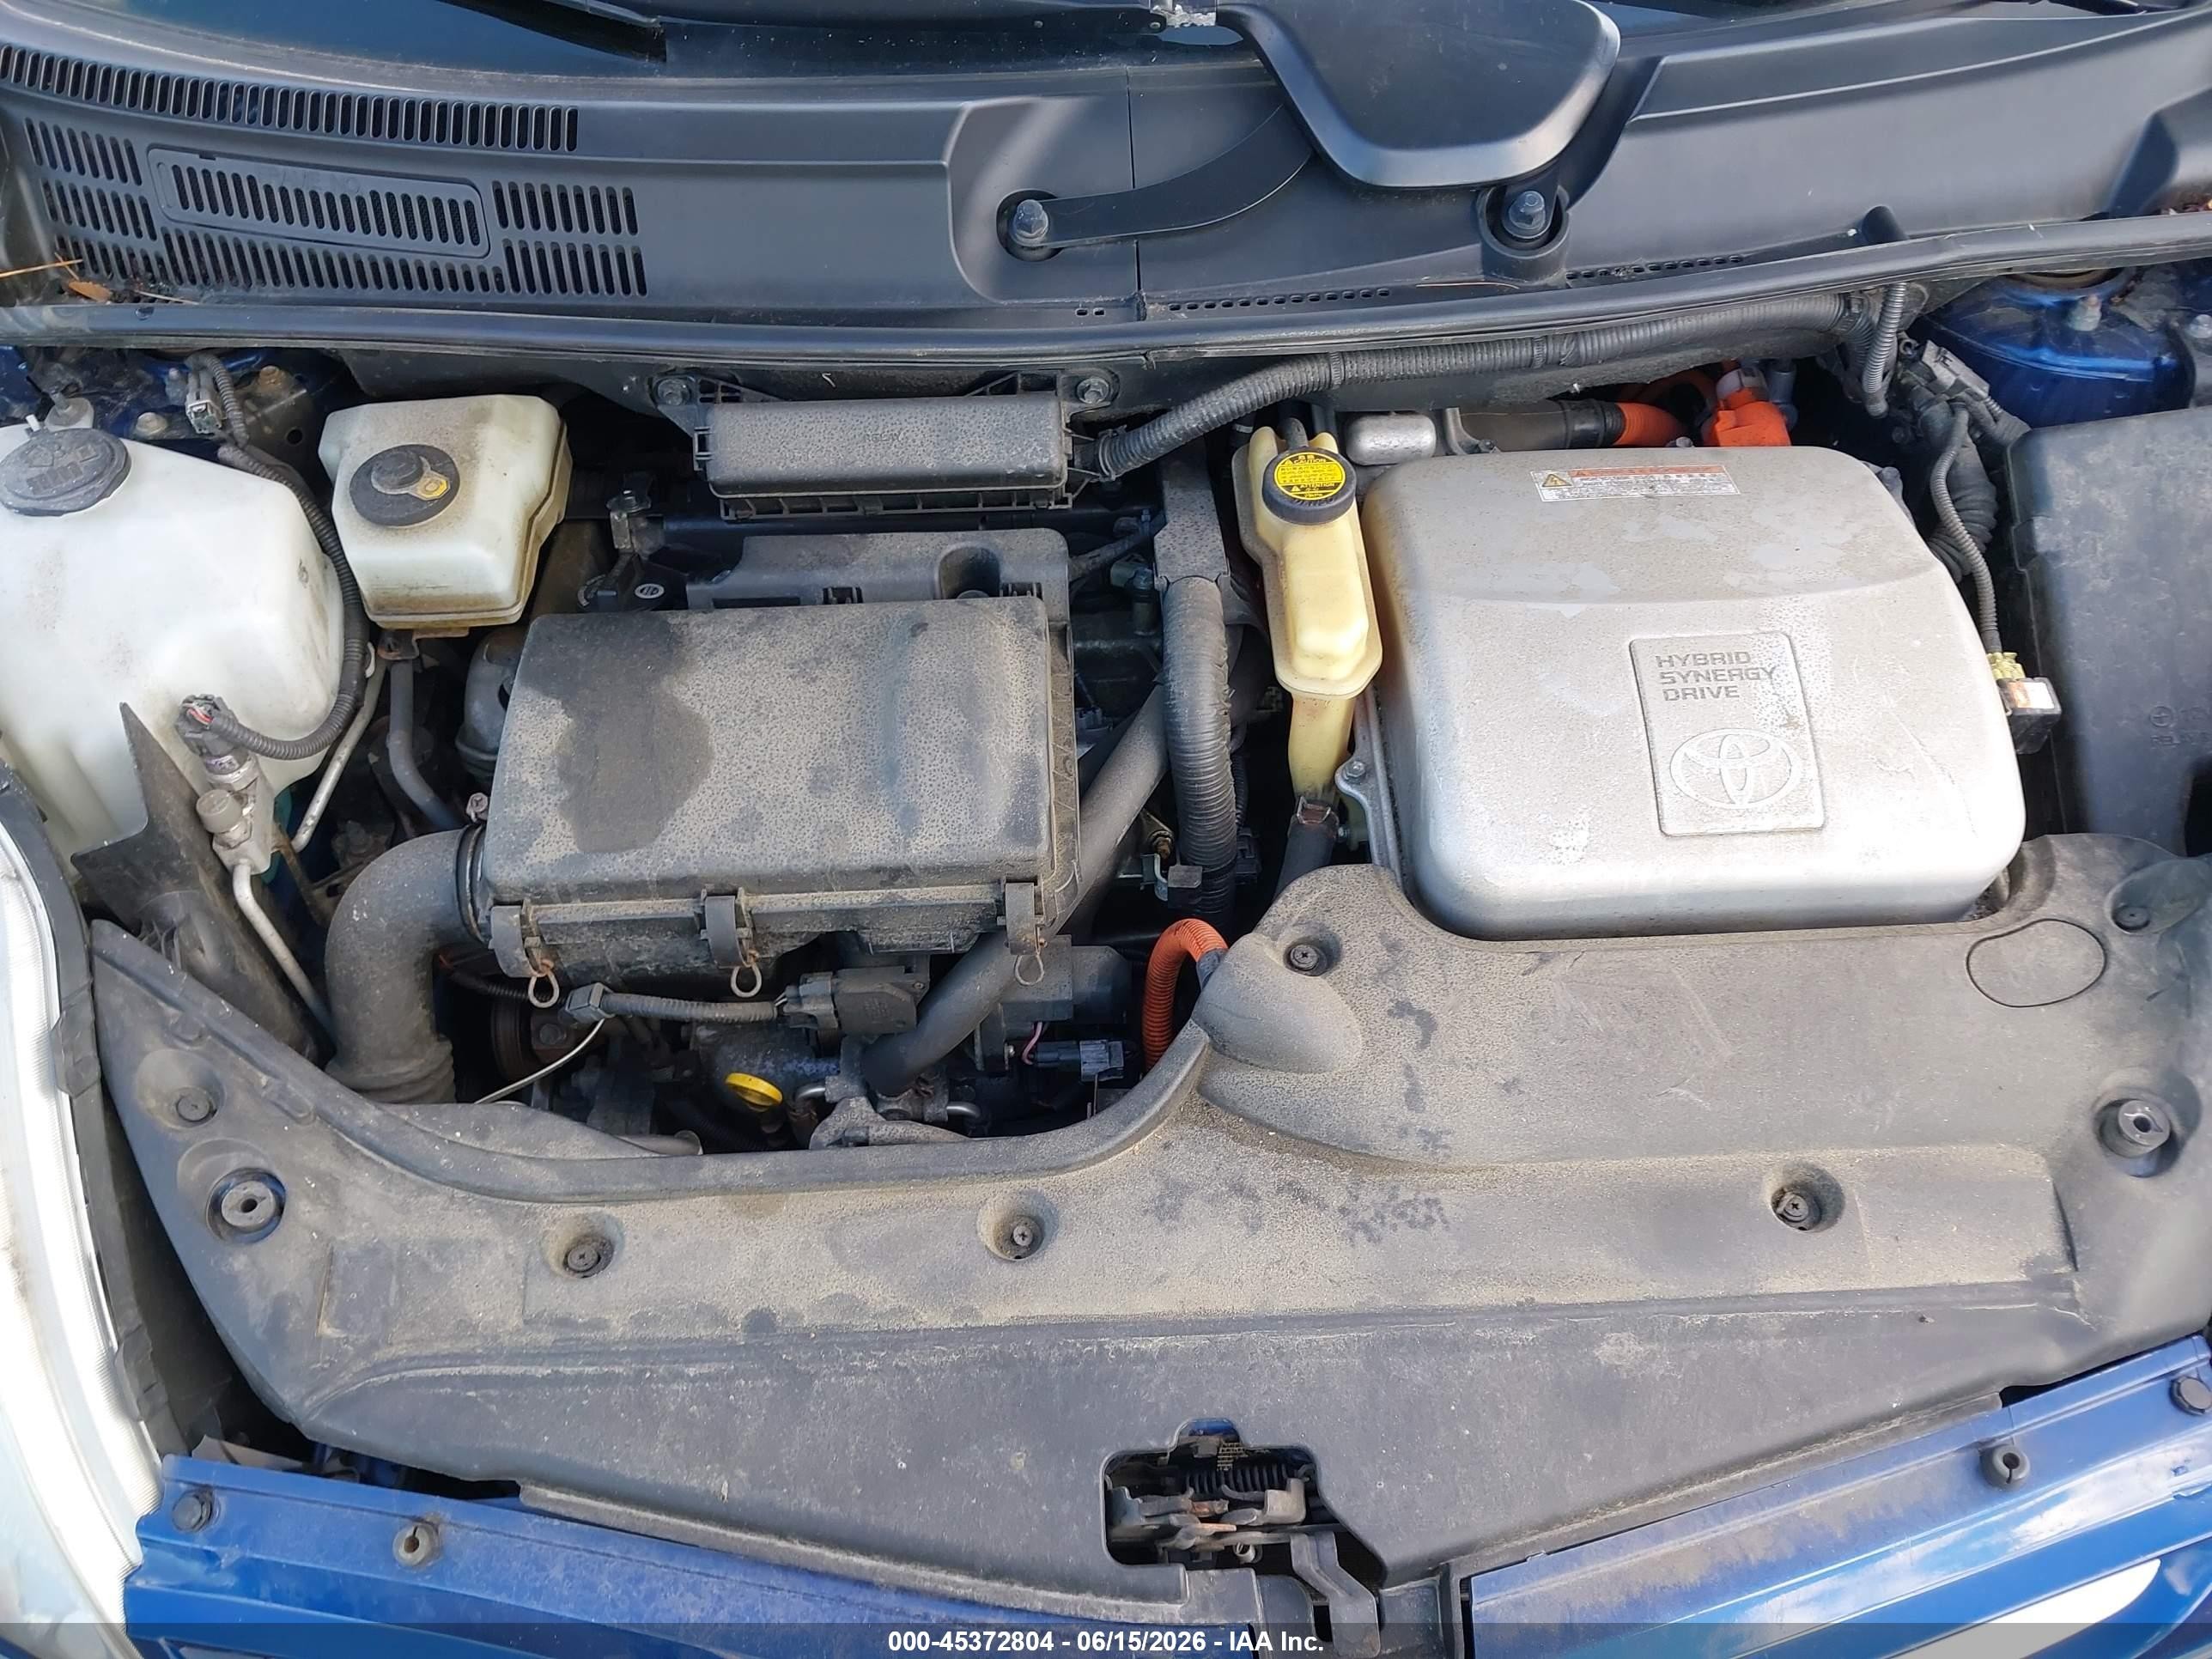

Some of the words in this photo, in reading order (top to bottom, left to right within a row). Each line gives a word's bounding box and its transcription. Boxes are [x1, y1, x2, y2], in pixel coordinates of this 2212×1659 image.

[1655, 651, 1752, 667] HYBRID
[1659, 665, 1778, 684] SYNERGY
[1662, 685, 1740, 701] DRIVE
